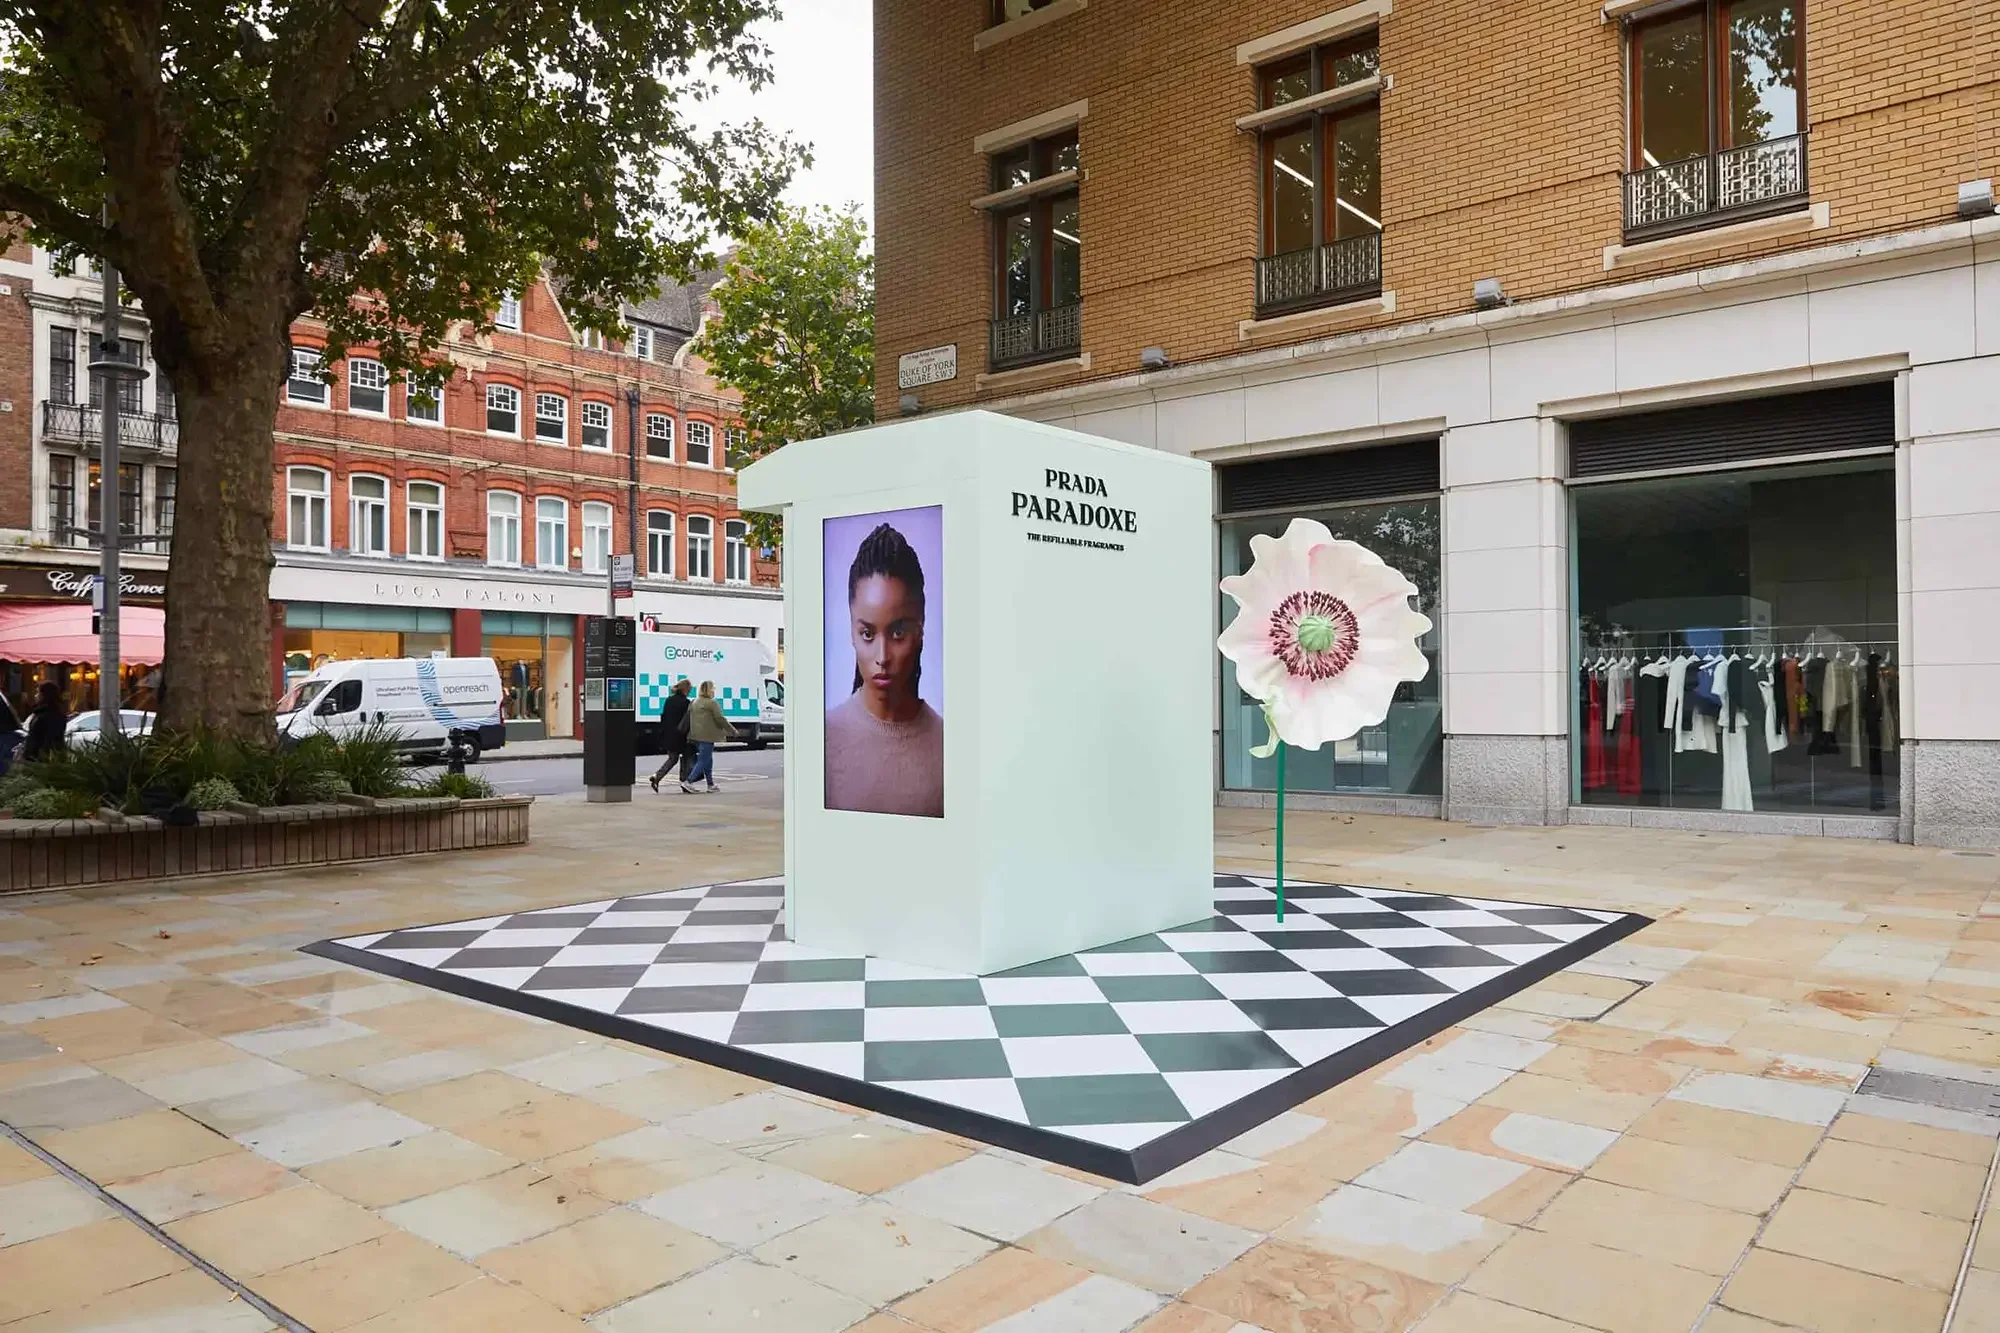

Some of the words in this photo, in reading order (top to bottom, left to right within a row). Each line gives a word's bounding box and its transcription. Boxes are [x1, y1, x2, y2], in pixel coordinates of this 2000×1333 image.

[900, 367, 921, 379] DUKE
[922, 364, 932, 375] OF
[933, 360, 954, 371] YORK
[1045, 468, 1108, 497] PRADA
[1011, 491, 1137, 533] PARADOXE
[1027, 532, 1041, 542] THE
[1042, 534, 1083, 547] REFILLABLE
[47, 570, 96, 597] Caff
[118, 573, 165, 595] Conce
[374, 583, 442, 599] LUCA
[464, 587, 555, 604] FALONI
[665, 646, 713, 660] ecourier
[443, 683, 489, 695] openreach
